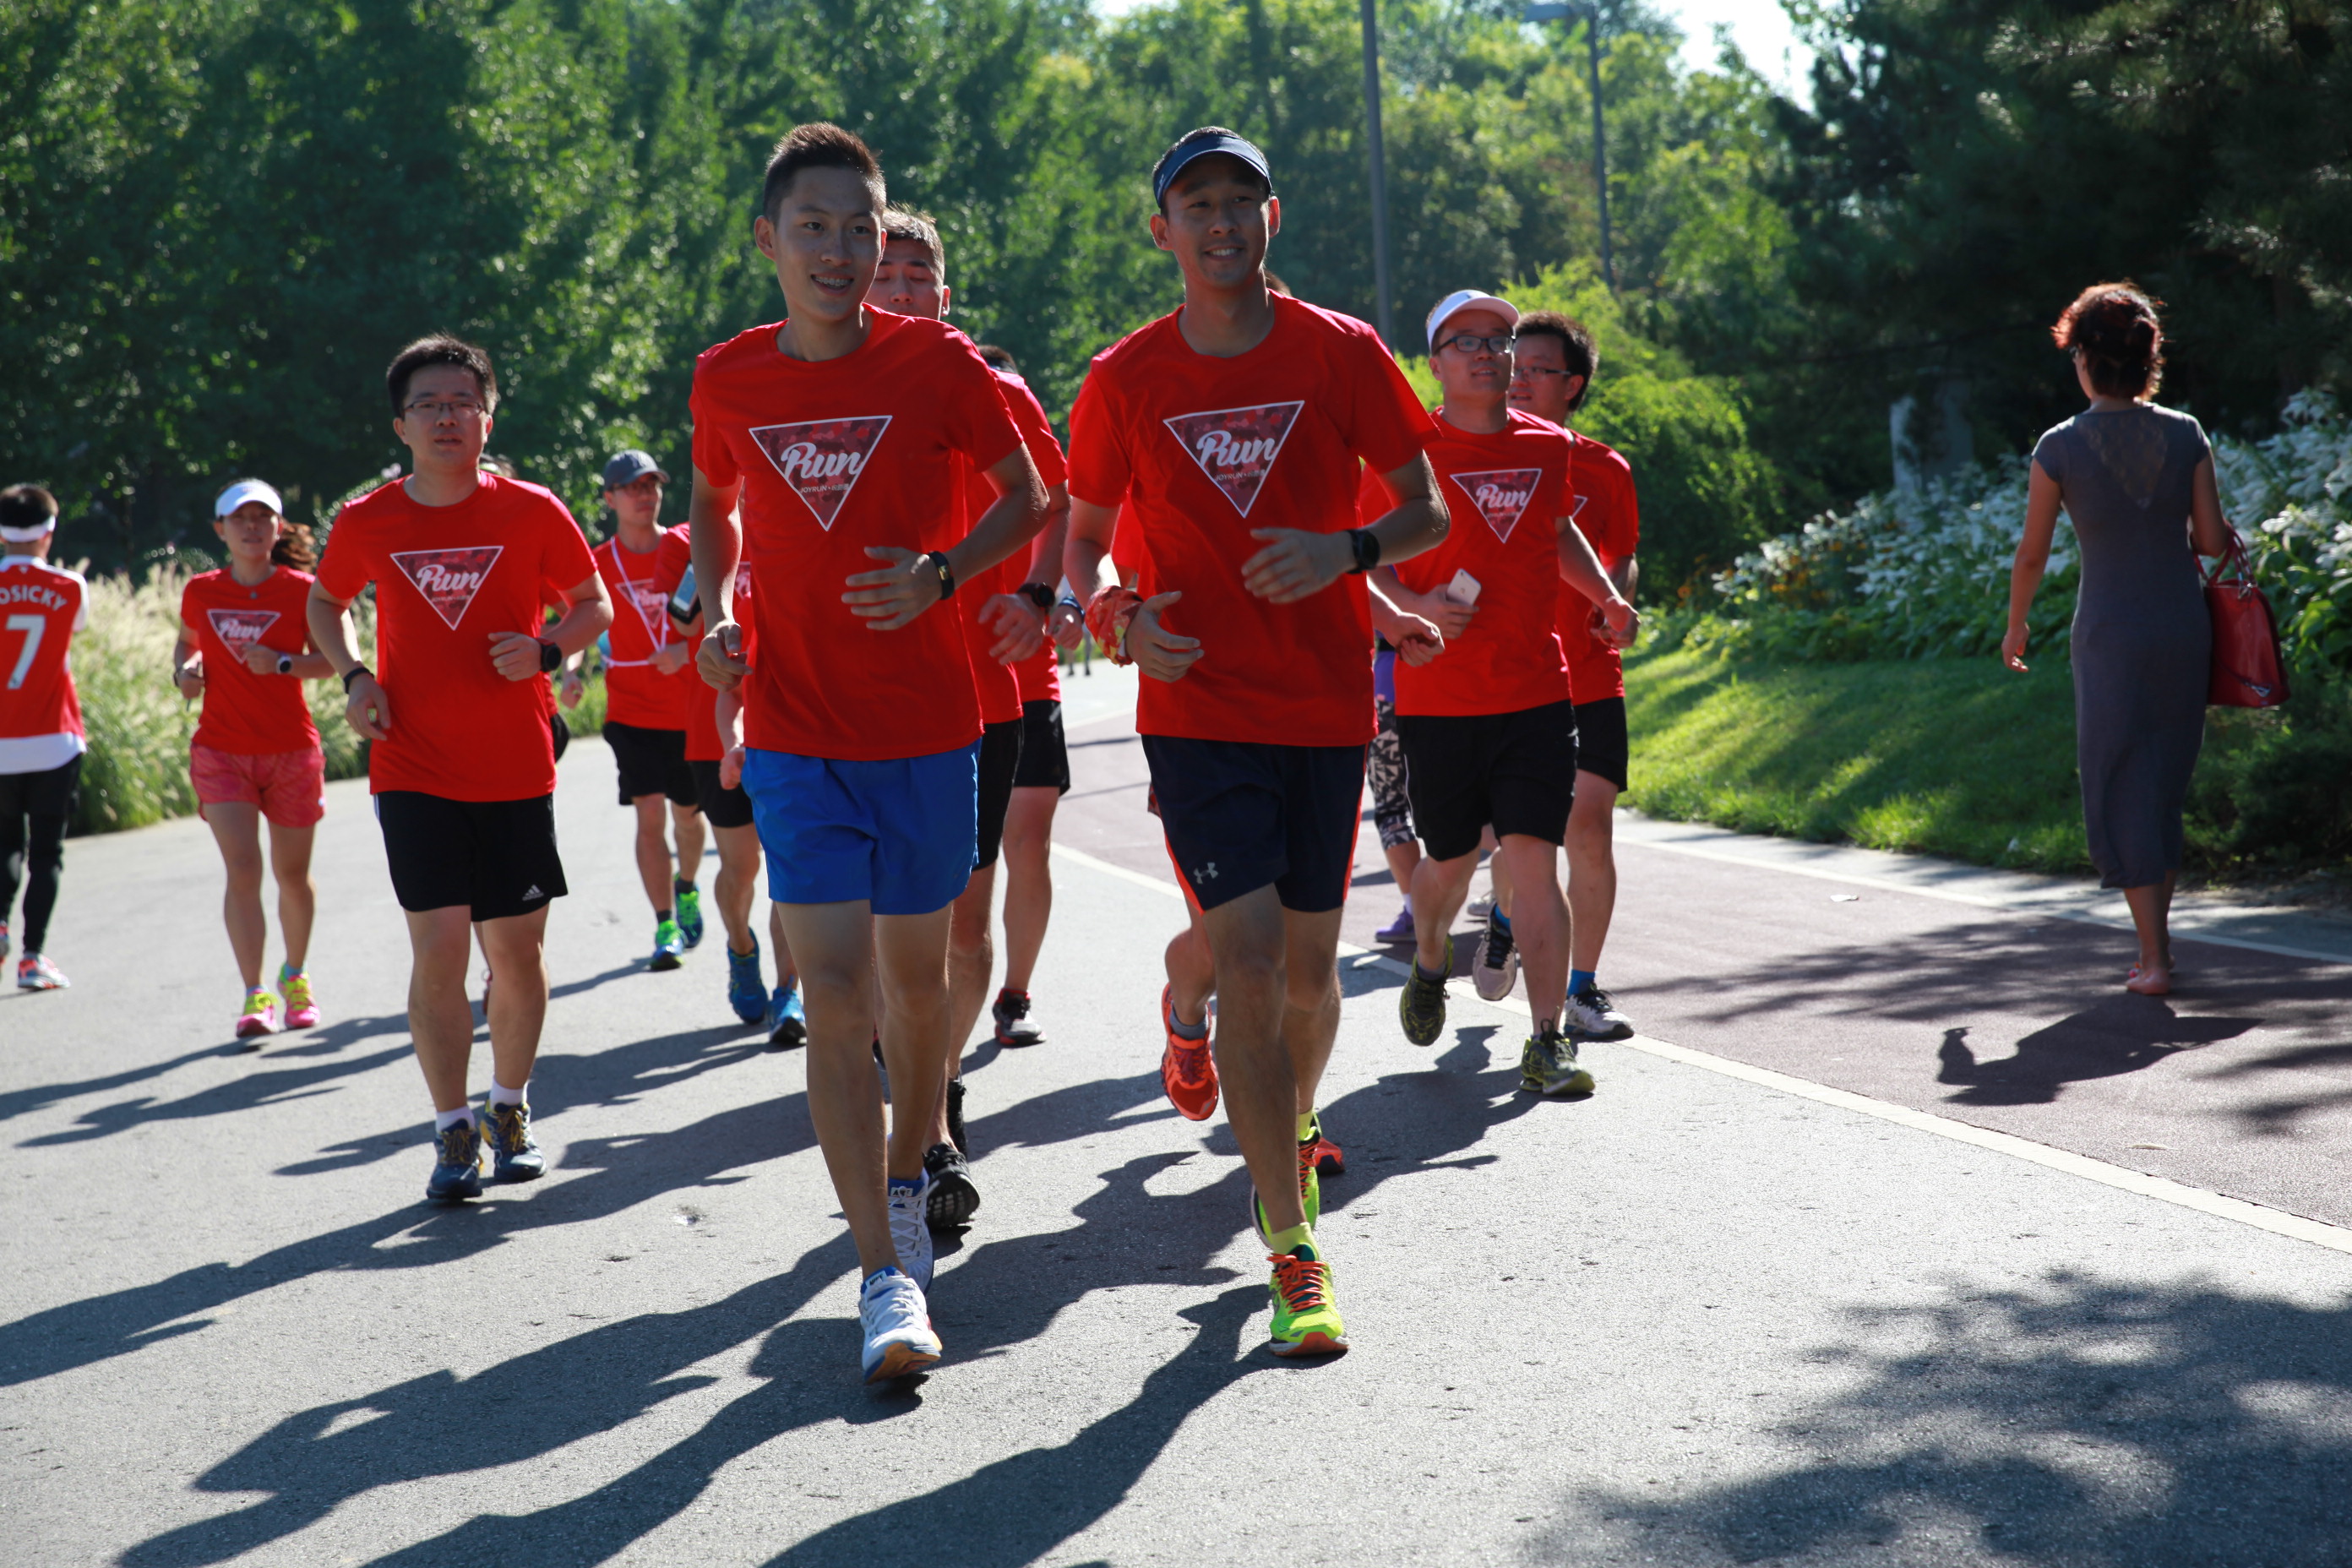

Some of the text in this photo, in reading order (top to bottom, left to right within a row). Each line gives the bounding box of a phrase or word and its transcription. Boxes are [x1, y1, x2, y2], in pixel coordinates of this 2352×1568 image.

[781, 442, 864, 480] Run
[1196, 430, 1278, 466] Run
[800, 485, 827, 493] JOYRUN
[1476, 484, 1528, 508] Run
[416, 564, 482, 591] Run
[6, 614, 46, 689] 7
